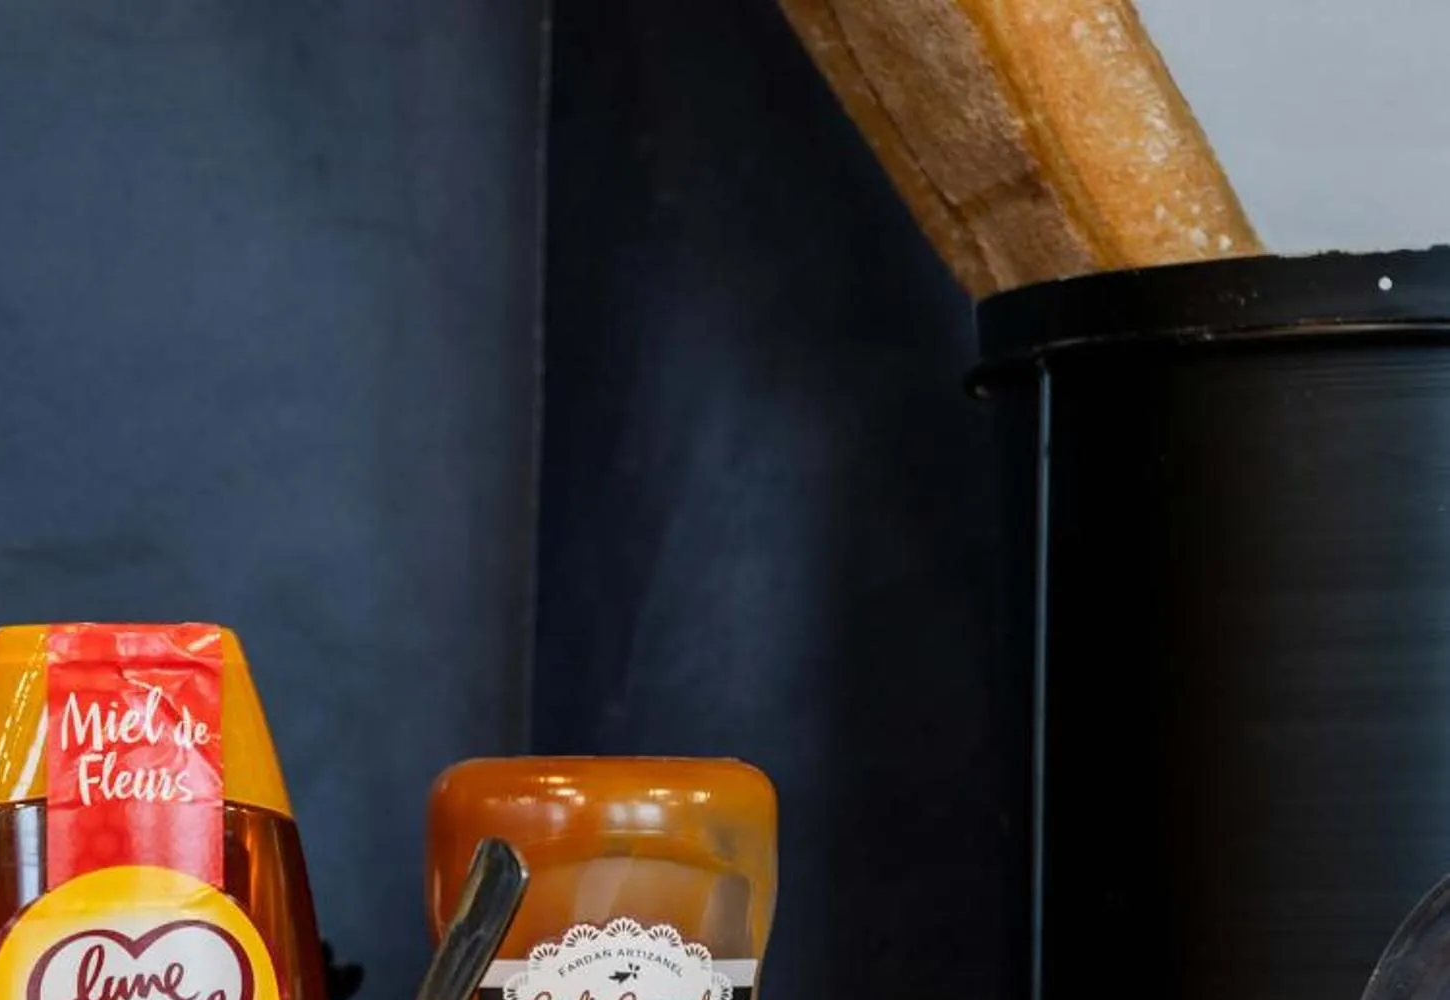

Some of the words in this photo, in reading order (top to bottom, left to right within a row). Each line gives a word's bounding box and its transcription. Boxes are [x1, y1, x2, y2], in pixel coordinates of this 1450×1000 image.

[60, 686, 164, 751] Miel
[174, 705, 212, 749] de
[78, 752, 194, 807] Fleurs
[617, 949, 683, 978] ARTIZANEL
